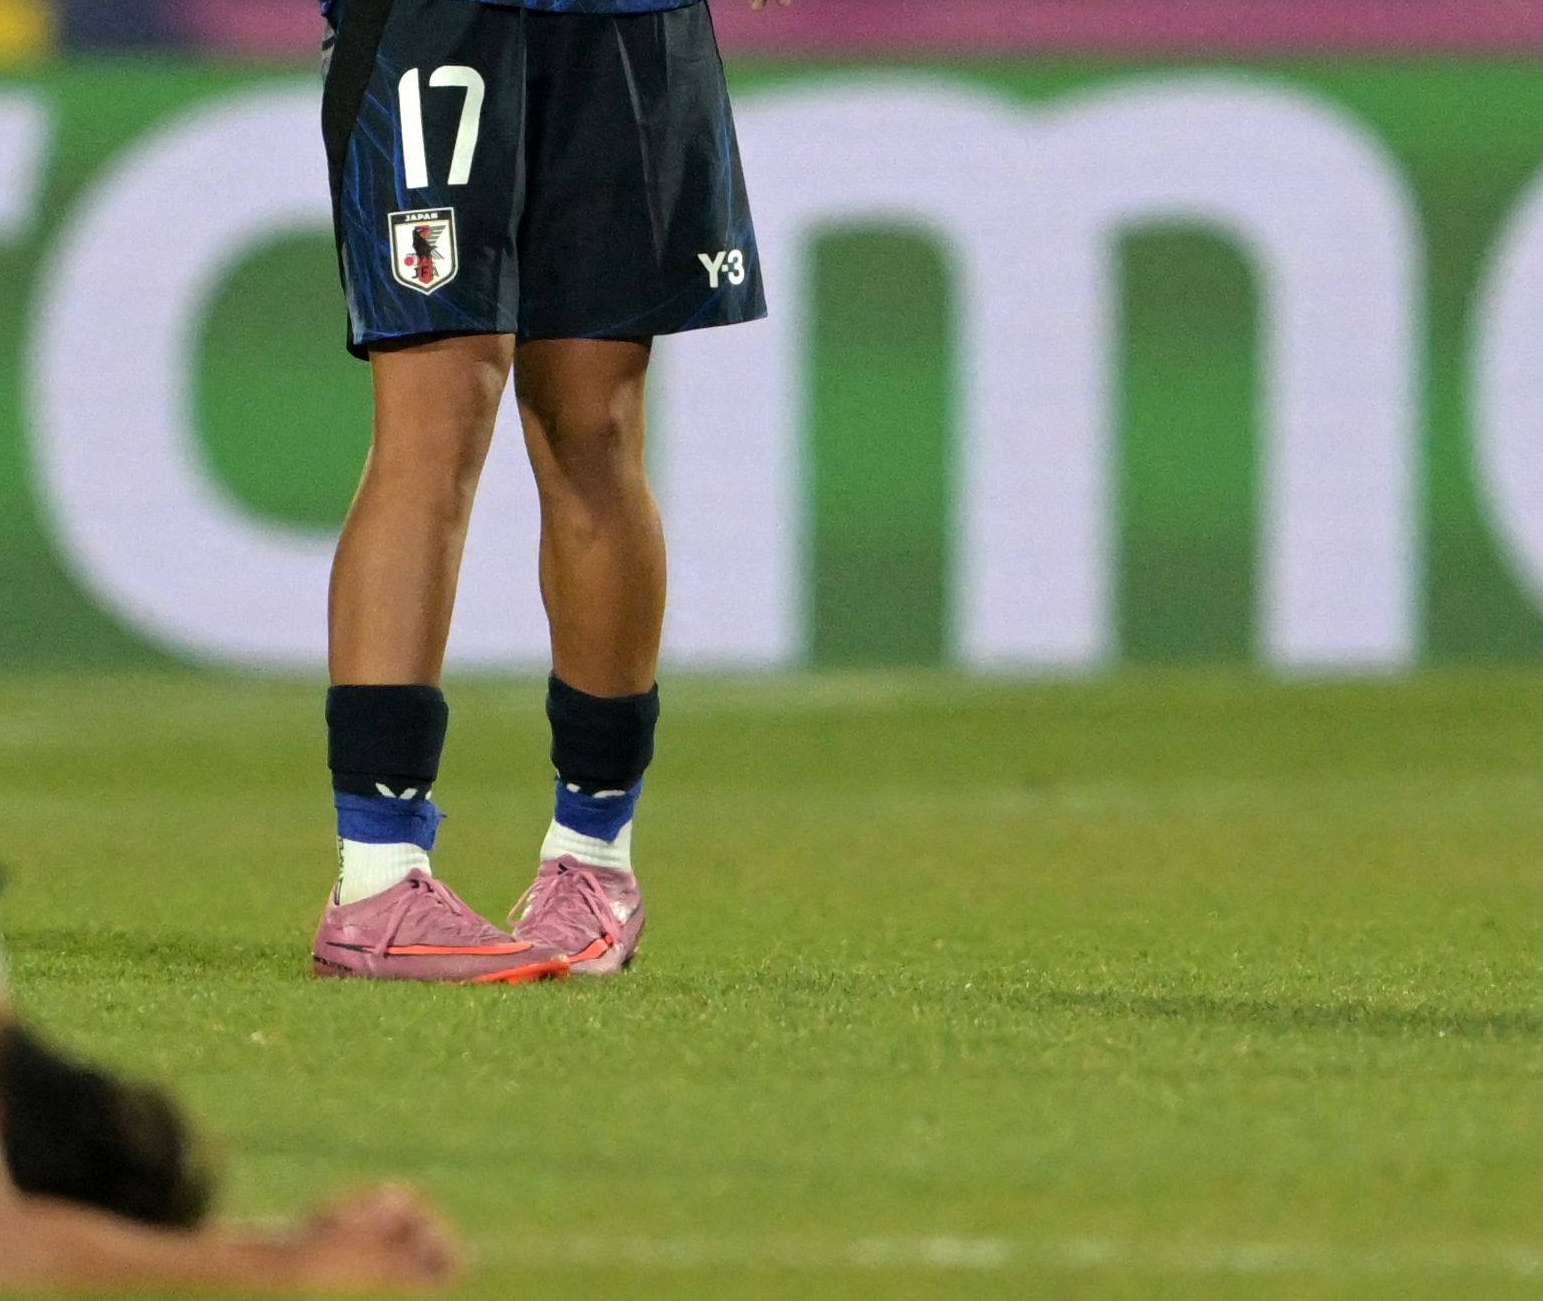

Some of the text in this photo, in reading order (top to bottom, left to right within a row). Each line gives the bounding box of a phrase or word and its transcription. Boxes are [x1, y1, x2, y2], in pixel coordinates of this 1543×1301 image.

[398, 64, 486, 189] 17
[404, 212, 439, 222] JAPAN
[697, 249, 746, 288] Y-3
